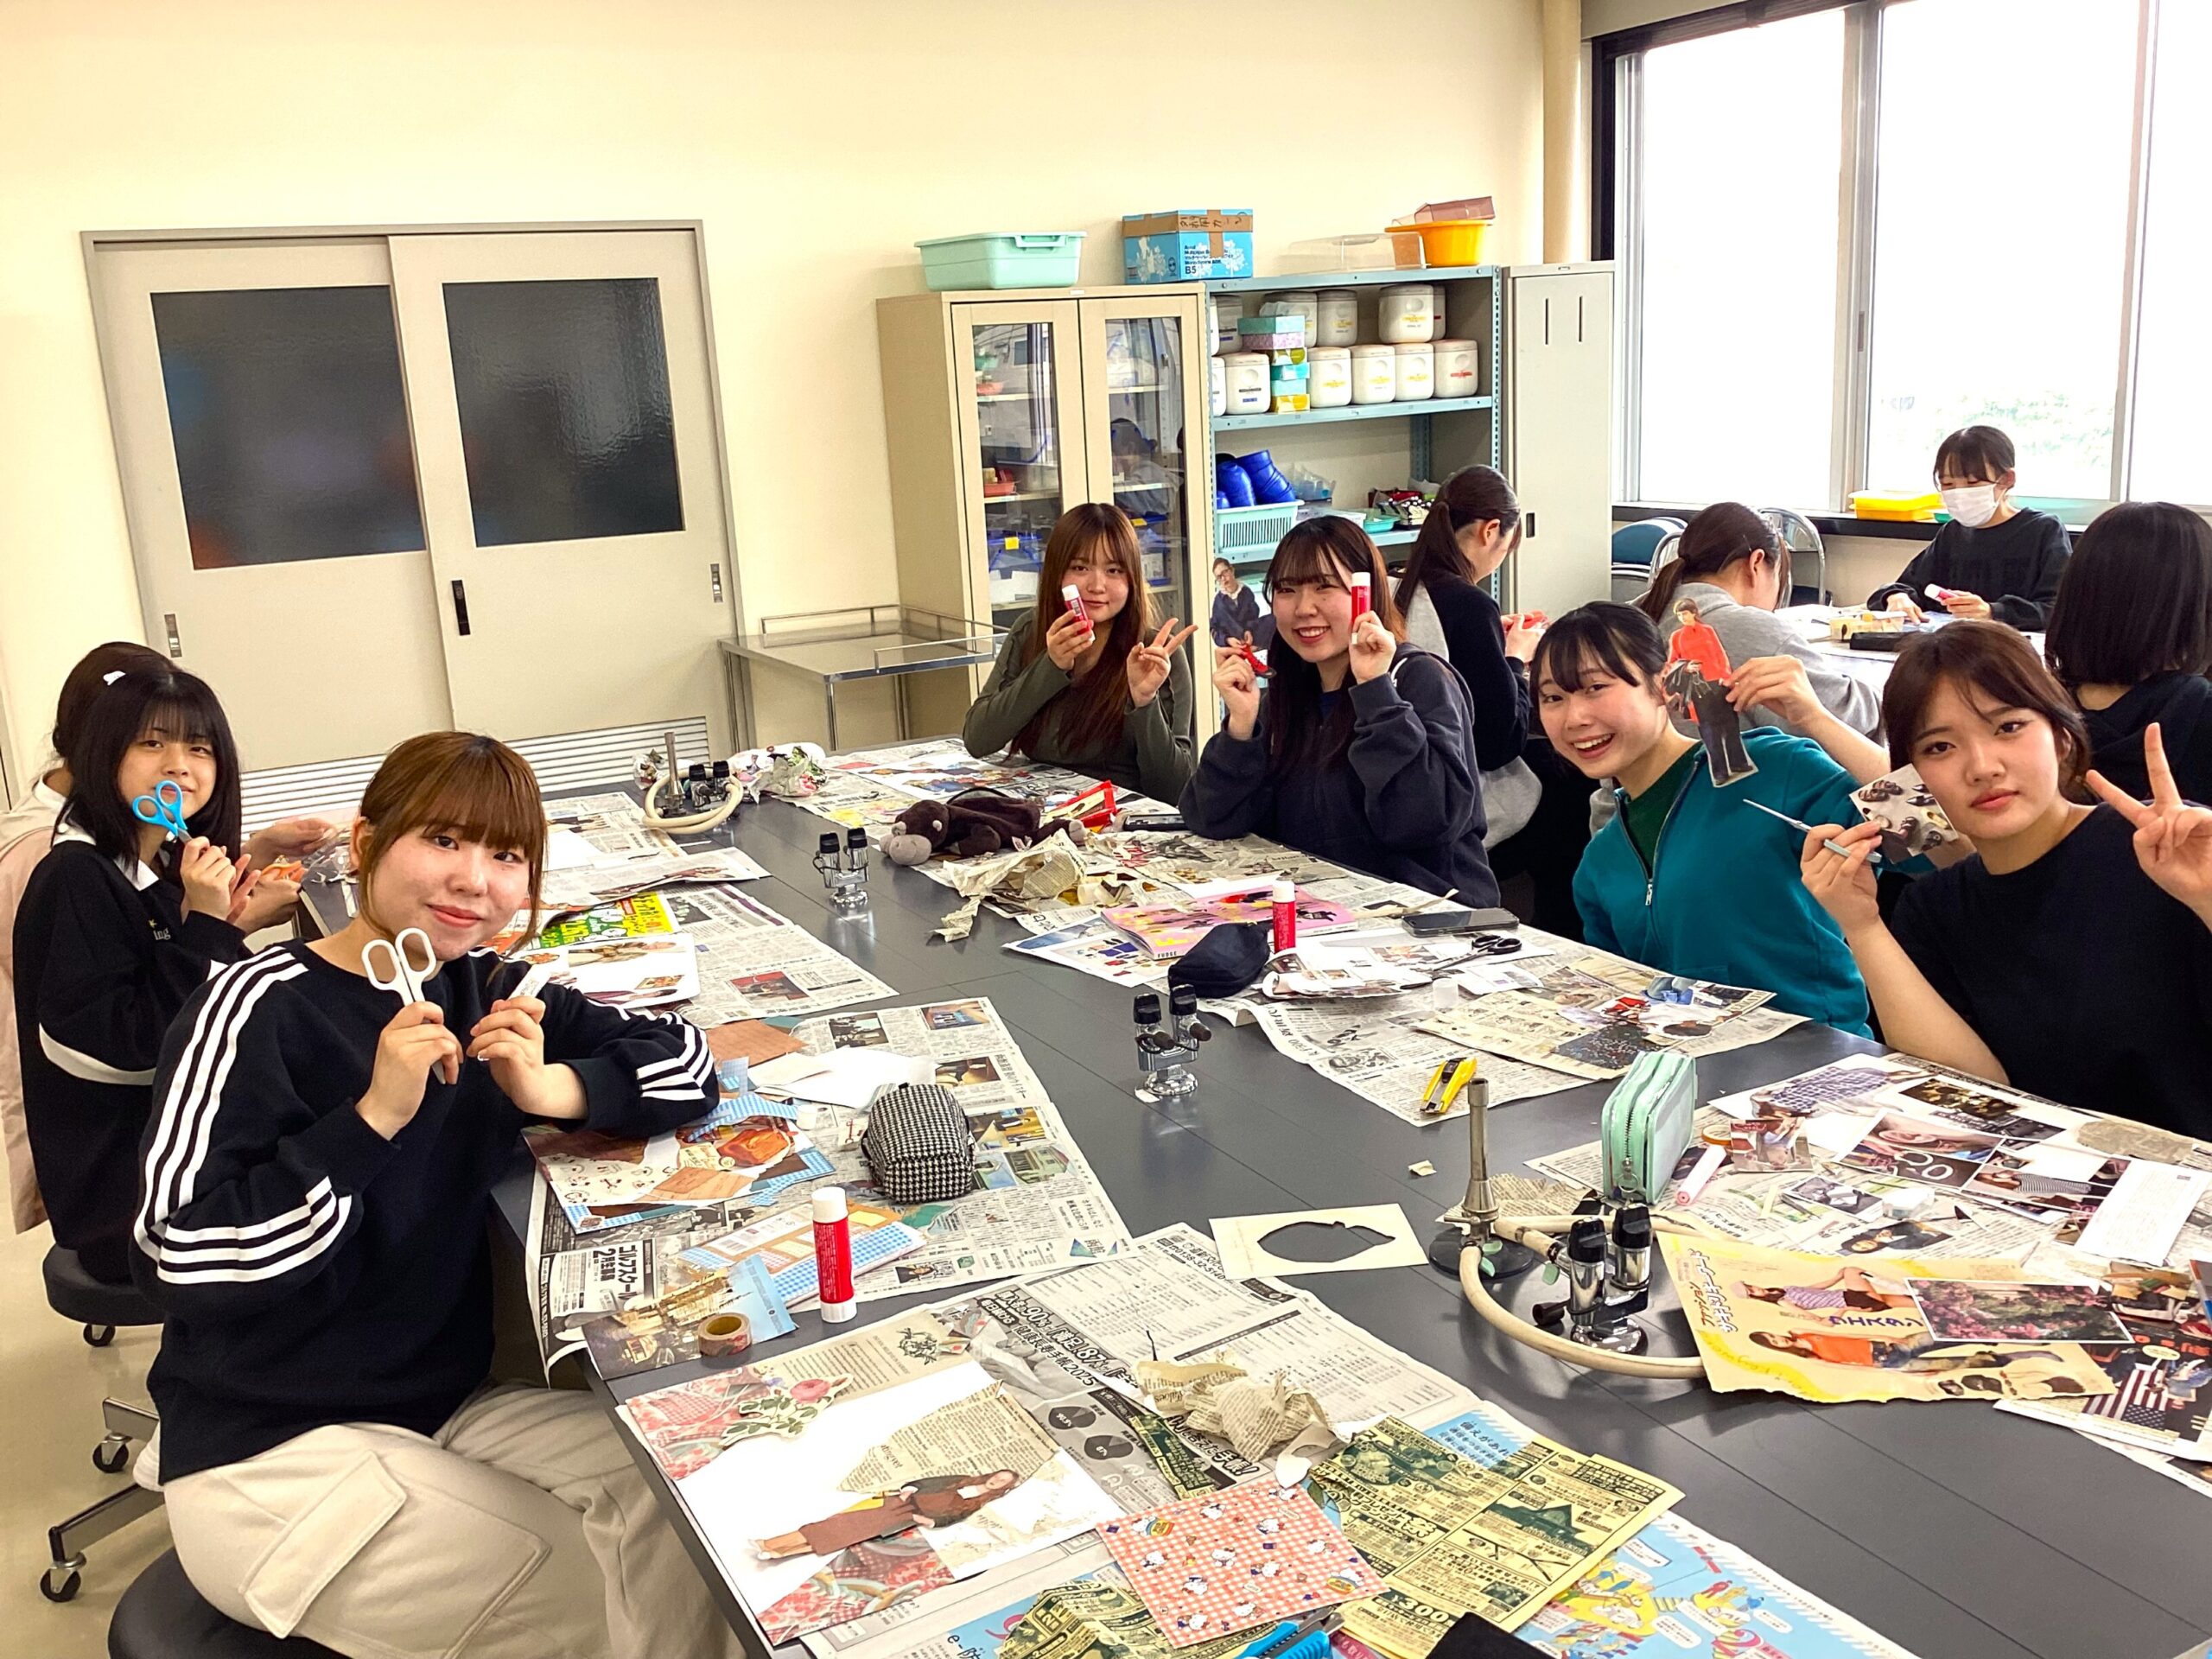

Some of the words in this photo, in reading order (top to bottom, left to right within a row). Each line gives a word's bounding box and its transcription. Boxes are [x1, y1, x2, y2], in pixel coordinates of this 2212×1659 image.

[618, 1245, 634, 1298] ゴルフスクール
[1688, 1248, 1737, 1332] サキドリキーワード
[1689, 1281, 1713, 1326] ファッション
[1829, 1315, 1923, 1327] ウエスタン
[1013, 1323, 1098, 1387] 健康長寿手帳2025
[1575, 1515, 1612, 1534] Welcome
